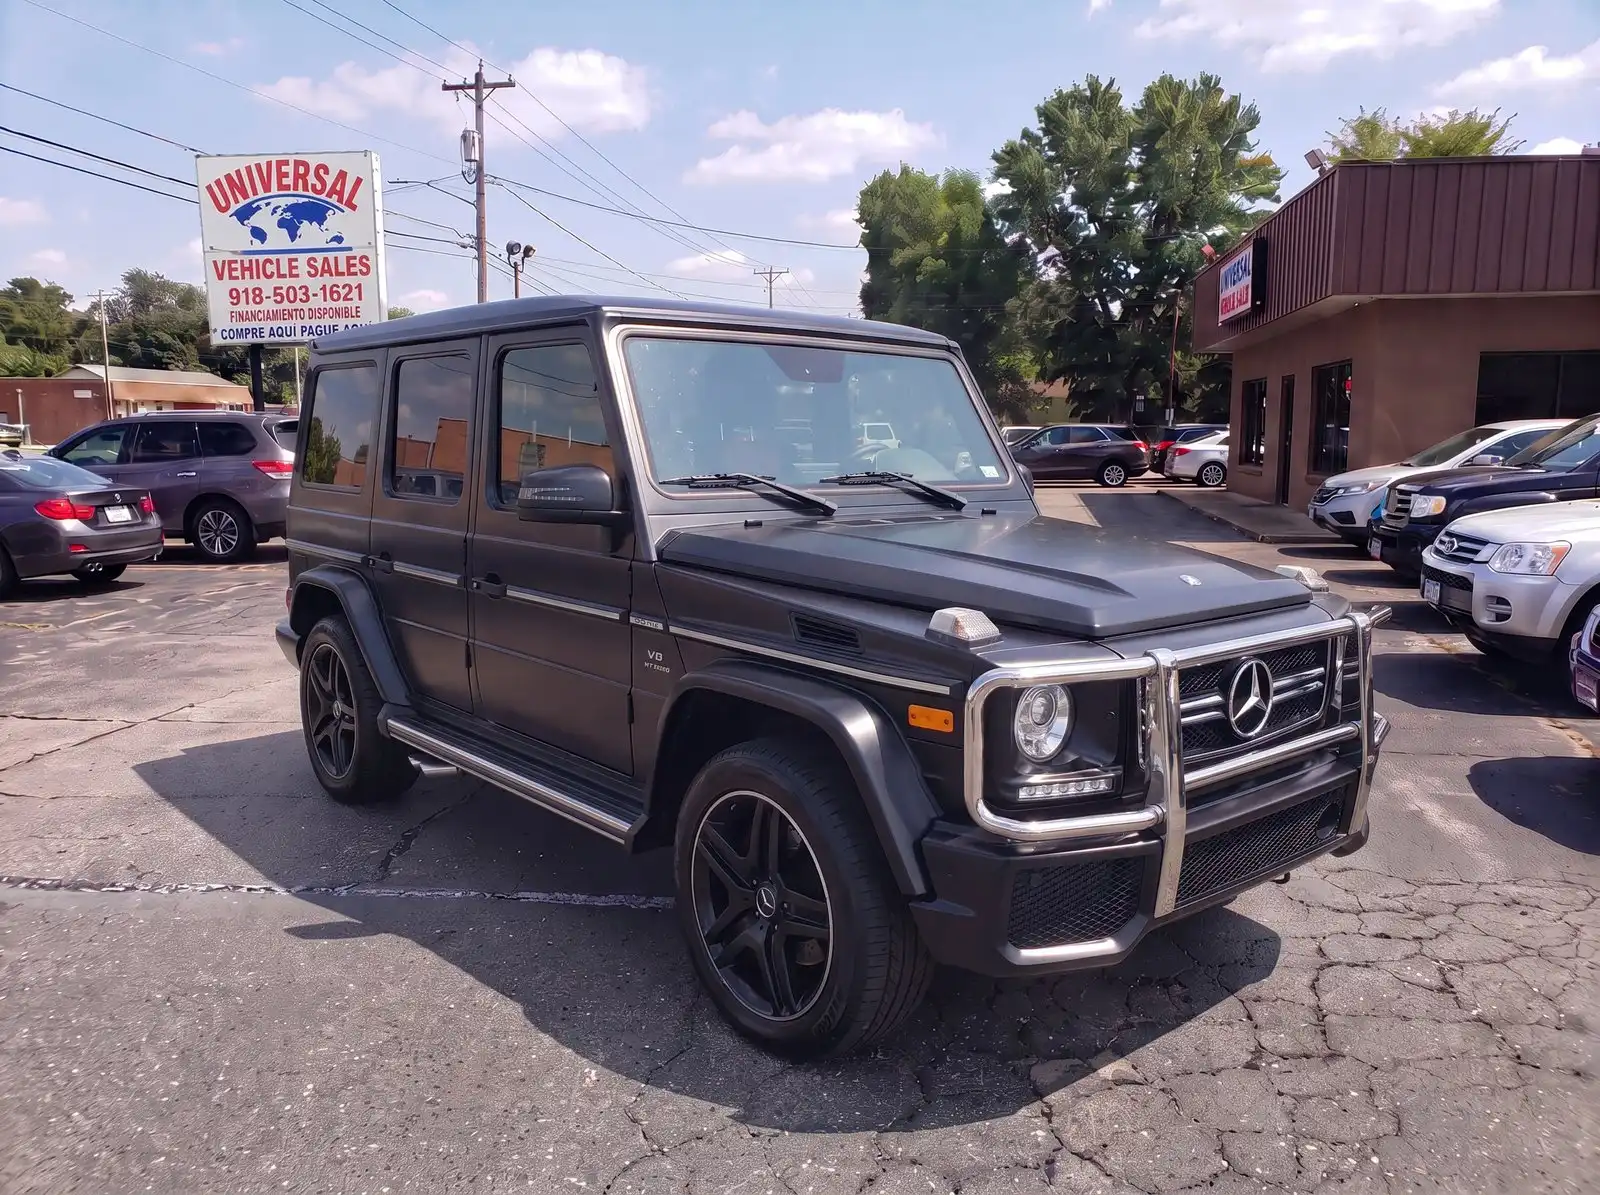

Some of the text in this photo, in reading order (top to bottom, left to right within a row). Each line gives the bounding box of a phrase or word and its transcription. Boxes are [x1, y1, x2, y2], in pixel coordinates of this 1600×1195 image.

[205, 159, 363, 214] UNIVERSAL
[212, 254, 371, 281] VEHICLE SALES
[228, 283, 363, 307] 918-503-1621
[230, 305, 361, 323] FINANCIAMIENTO DISPONIBLE
[220, 326, 265, 340] COMPRE
